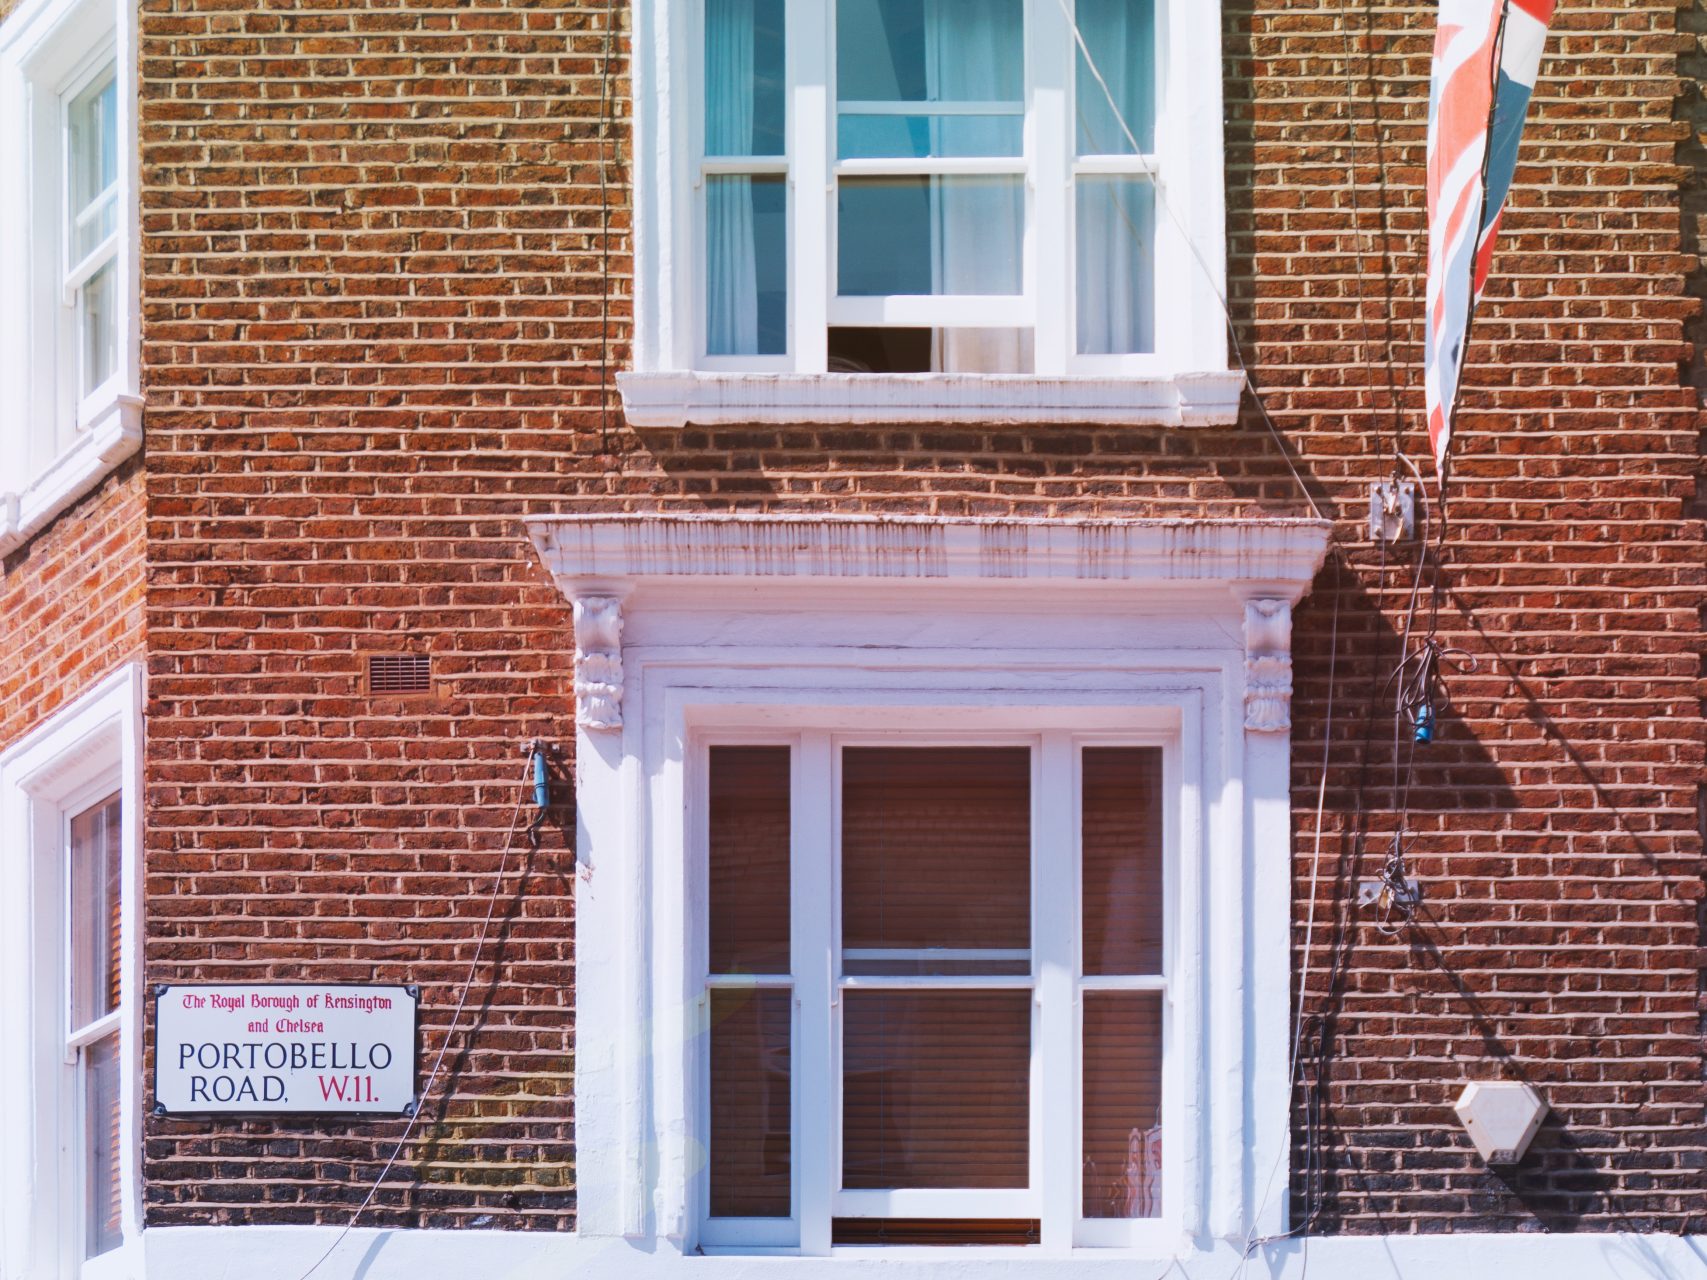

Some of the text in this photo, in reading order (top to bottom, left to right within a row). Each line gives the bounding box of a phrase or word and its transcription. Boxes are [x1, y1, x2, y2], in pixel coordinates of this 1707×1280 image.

[182, 993, 393, 1014] The Royal Borough of Kensington
[247, 1018, 324, 1033] and Chelsea
[178, 1042, 393, 1070] PORTOBELLO
[189, 1075, 289, 1104] ROAD,
